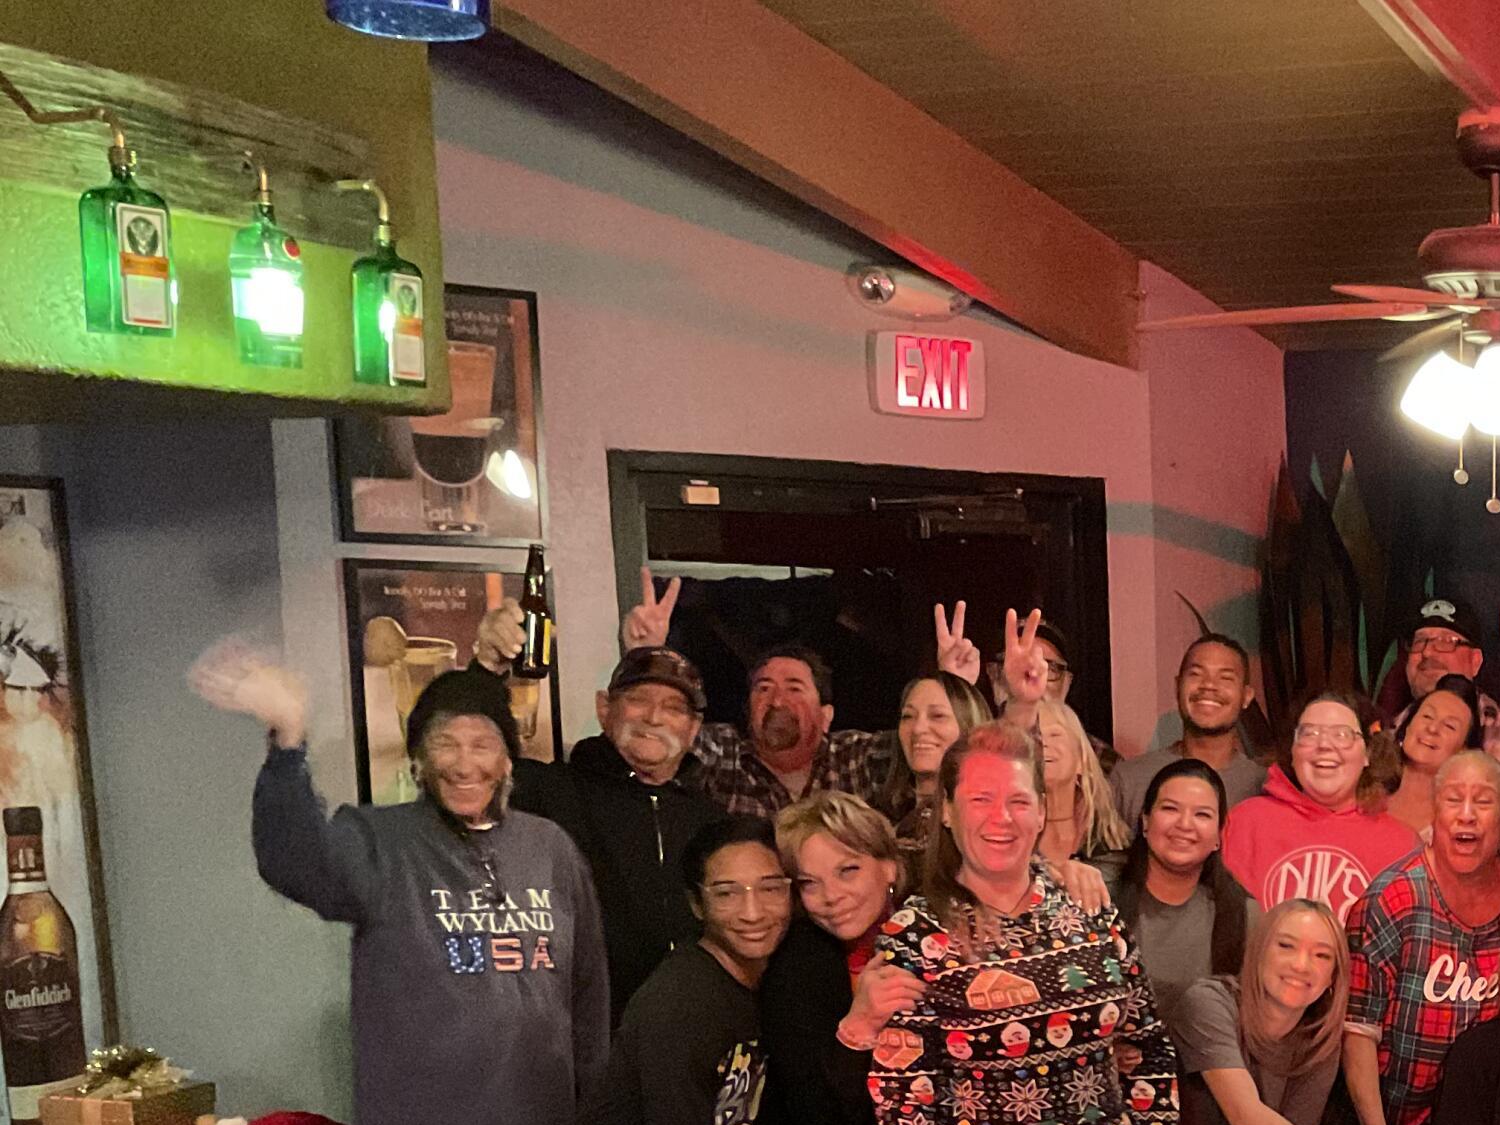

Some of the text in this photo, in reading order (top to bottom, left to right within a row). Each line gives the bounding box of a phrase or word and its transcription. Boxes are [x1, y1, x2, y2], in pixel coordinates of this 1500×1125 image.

[896, 335, 972, 411] EXIT
[431, 888, 552, 910] TEAM
[435, 911, 554, 933] WYLAND
[445, 935, 556, 973] USA
[5, 984, 71, 1010] Glenfiddich
